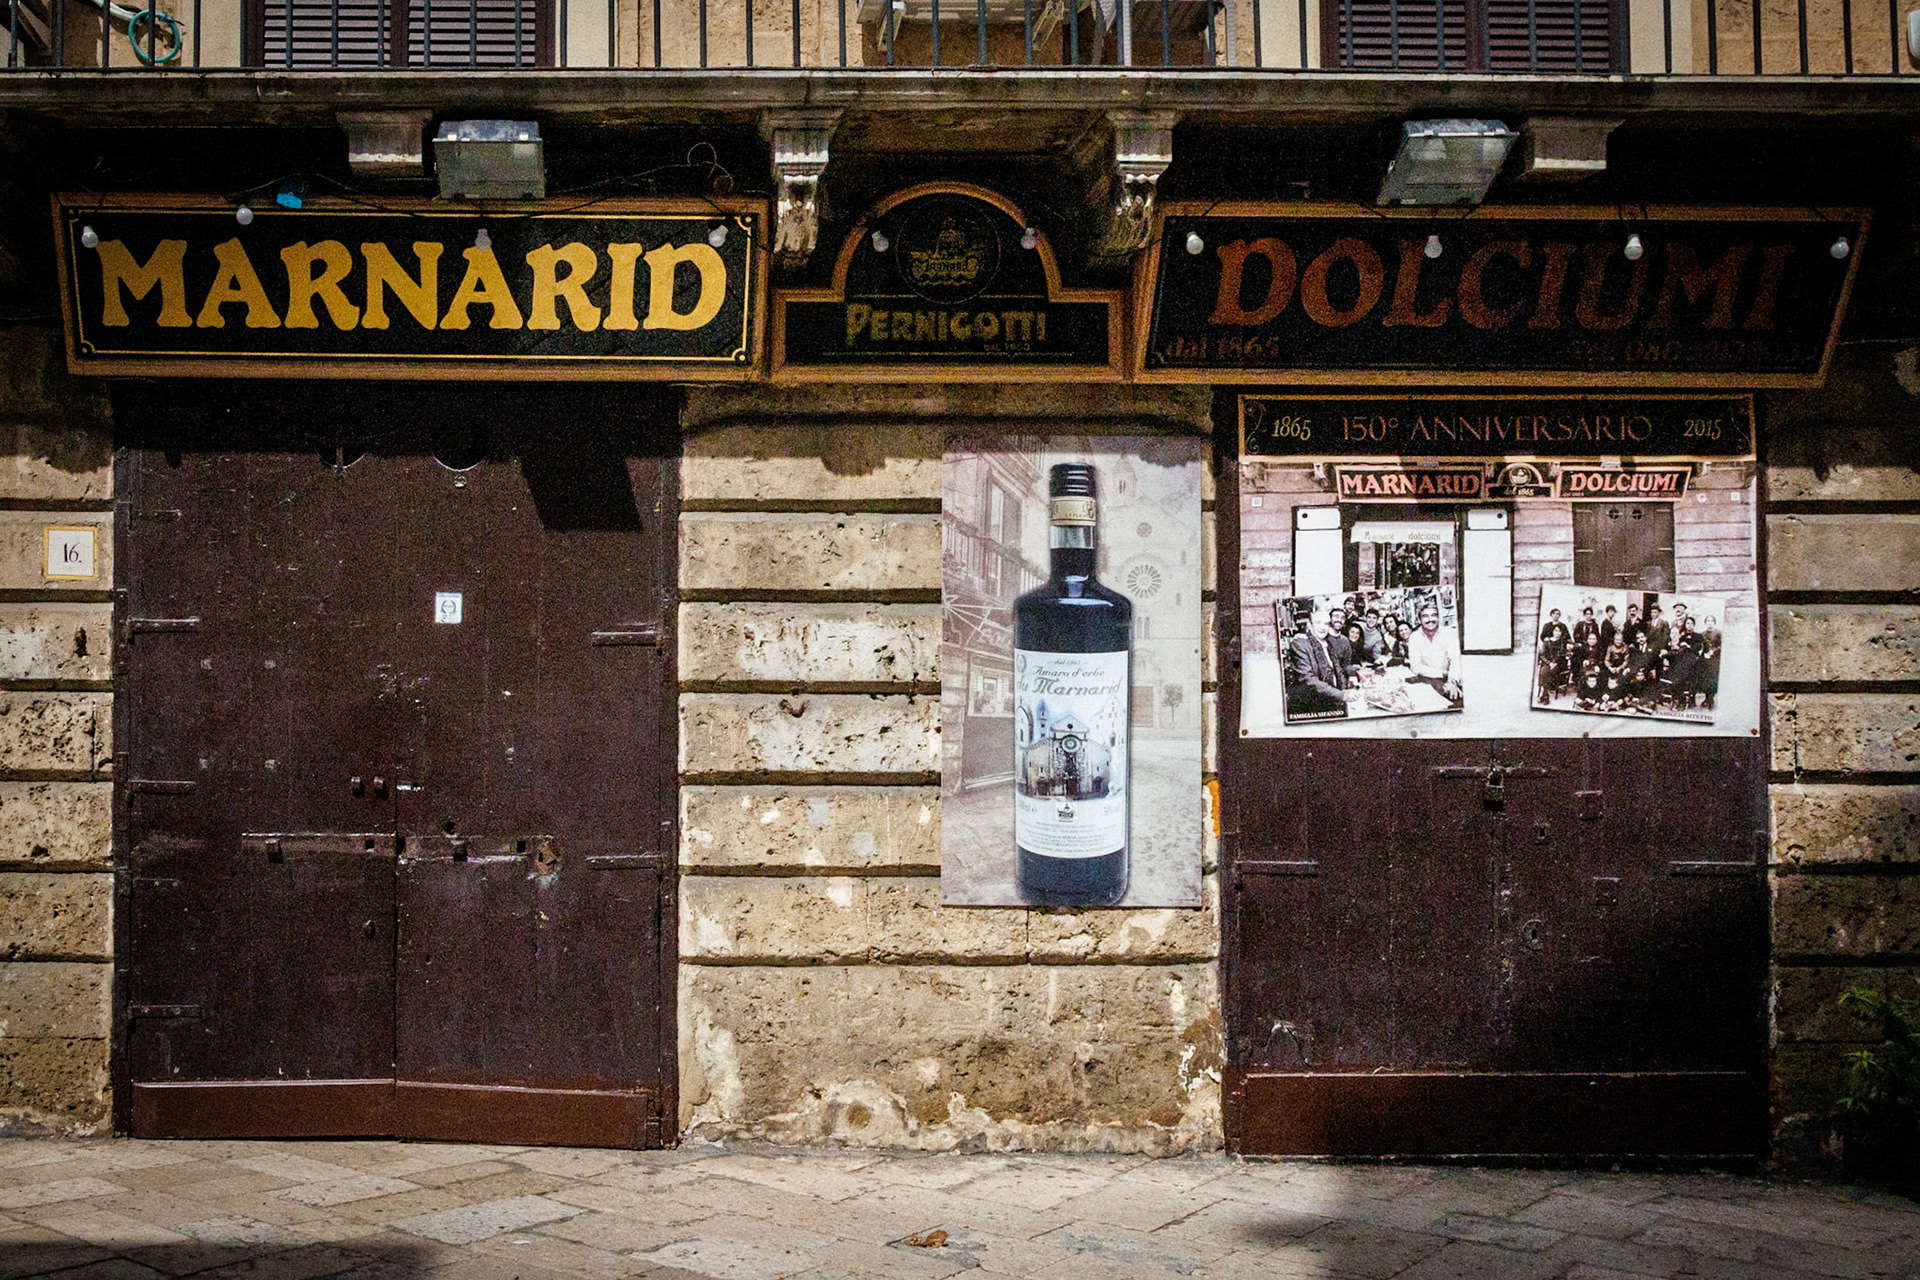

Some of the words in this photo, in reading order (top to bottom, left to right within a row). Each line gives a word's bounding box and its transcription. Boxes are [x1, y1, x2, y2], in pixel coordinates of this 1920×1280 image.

[97, 239, 728, 332] MARNARID
[1208, 235, 1797, 330] DOLCIUMI
[846, 303, 1046, 347] PERNIGOTTI
[1271, 415, 1311, 441] 1865
[1343, 415, 1399, 441] 150°
[1410, 415, 1653, 442] ANNIVERSARIO
[1683, 418, 1723, 440] 2015
[1342, 474, 1481, 495] MARNARID
[1571, 473, 1680, 491] DOLCIUMI
[1033, 665, 1070, 677] Amaro
[1071, 667, 1105, 678] d'erbe
[1031, 676, 1123, 696] Marnarid
